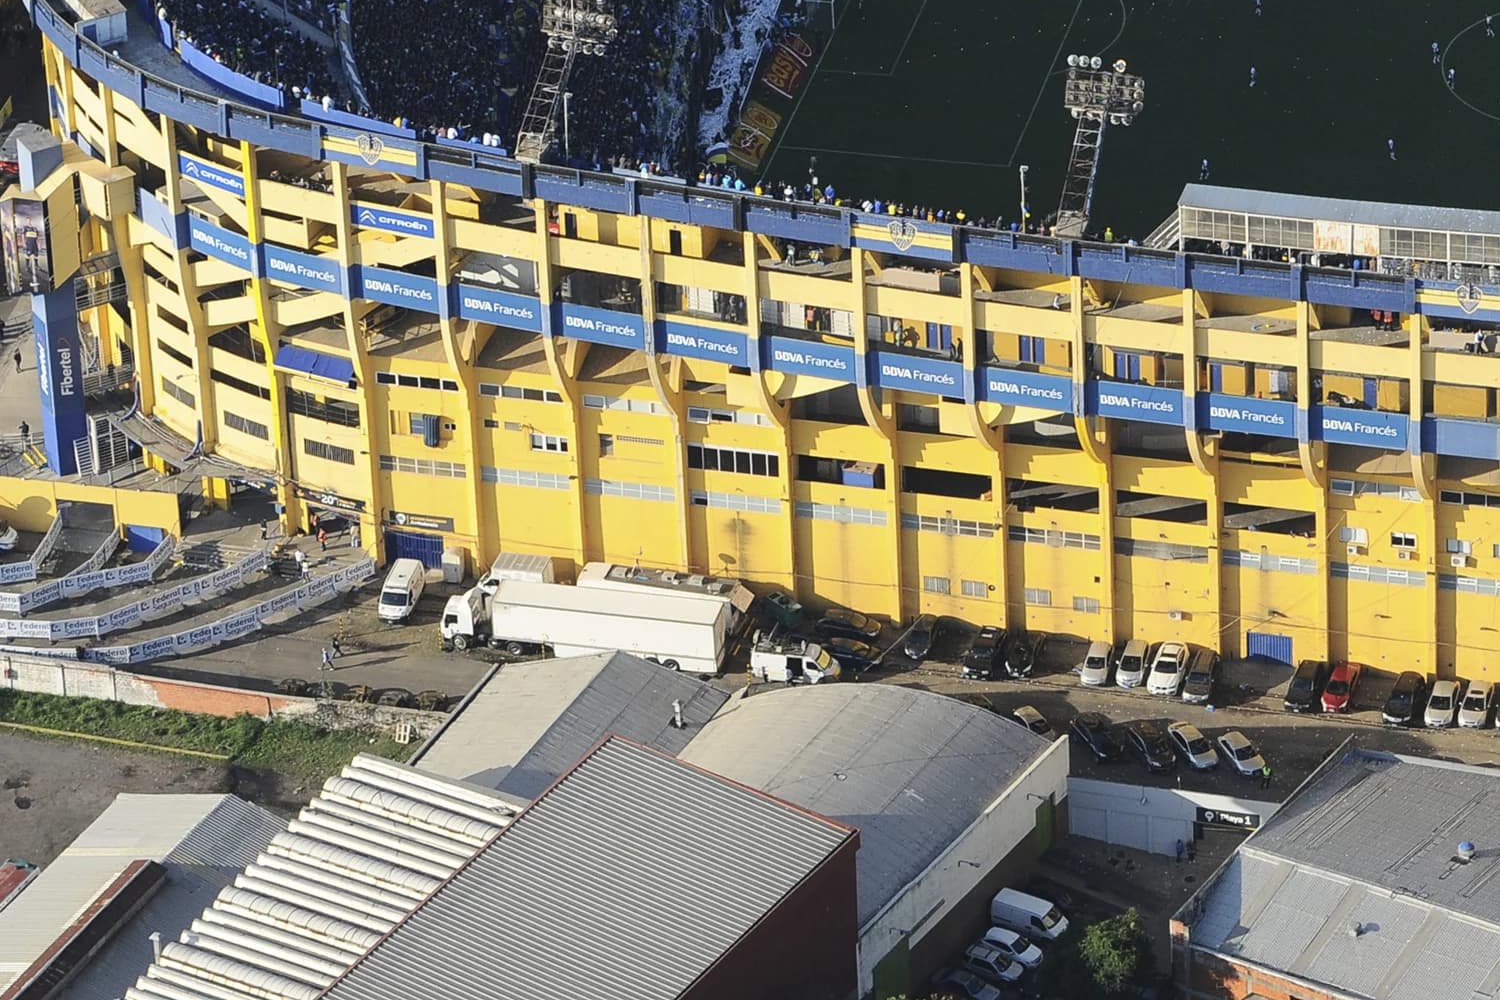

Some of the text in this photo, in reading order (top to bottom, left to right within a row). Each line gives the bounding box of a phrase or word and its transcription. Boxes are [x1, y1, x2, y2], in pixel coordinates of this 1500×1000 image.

[200, 170, 243, 190] CITROËN
[378, 215, 428, 230] CITROËN
[193, 229, 247, 260] BBVA Francés
[270, 258, 336, 283] BBVA Francés
[365, 280, 432, 301] BBVA Francés
[464, 298, 533, 319] BBVA Francés
[566, 316, 635, 337] BBVA Francés
[667, 334, 738, 355] BBVA Francés
[775, 350, 846, 370] BBVA Francés
[57, 348, 74, 396] Fibertel
[883, 366, 954, 385] BBVA Francés
[990, 381, 1063, 400] BBVA Francés
[1100, 395, 1174, 412] BBVA Francés
[1210, 407, 1284, 425] BBVA Francés
[1323, 419, 1397, 437] BBVA Francés
[0, 562, 33, 575] Federal
[118, 564, 150, 577] Federal
[213, 569, 240, 586] Federal
[32, 582, 59, 599] Federal
[152, 590, 181, 606] Federal
[110, 606, 139, 621] Federal
[64, 620, 96, 630] Federal
[225, 616, 256, 631] Federal
[142, 638, 174, 652] Federal
[1244, 816, 1252, 825] 1
